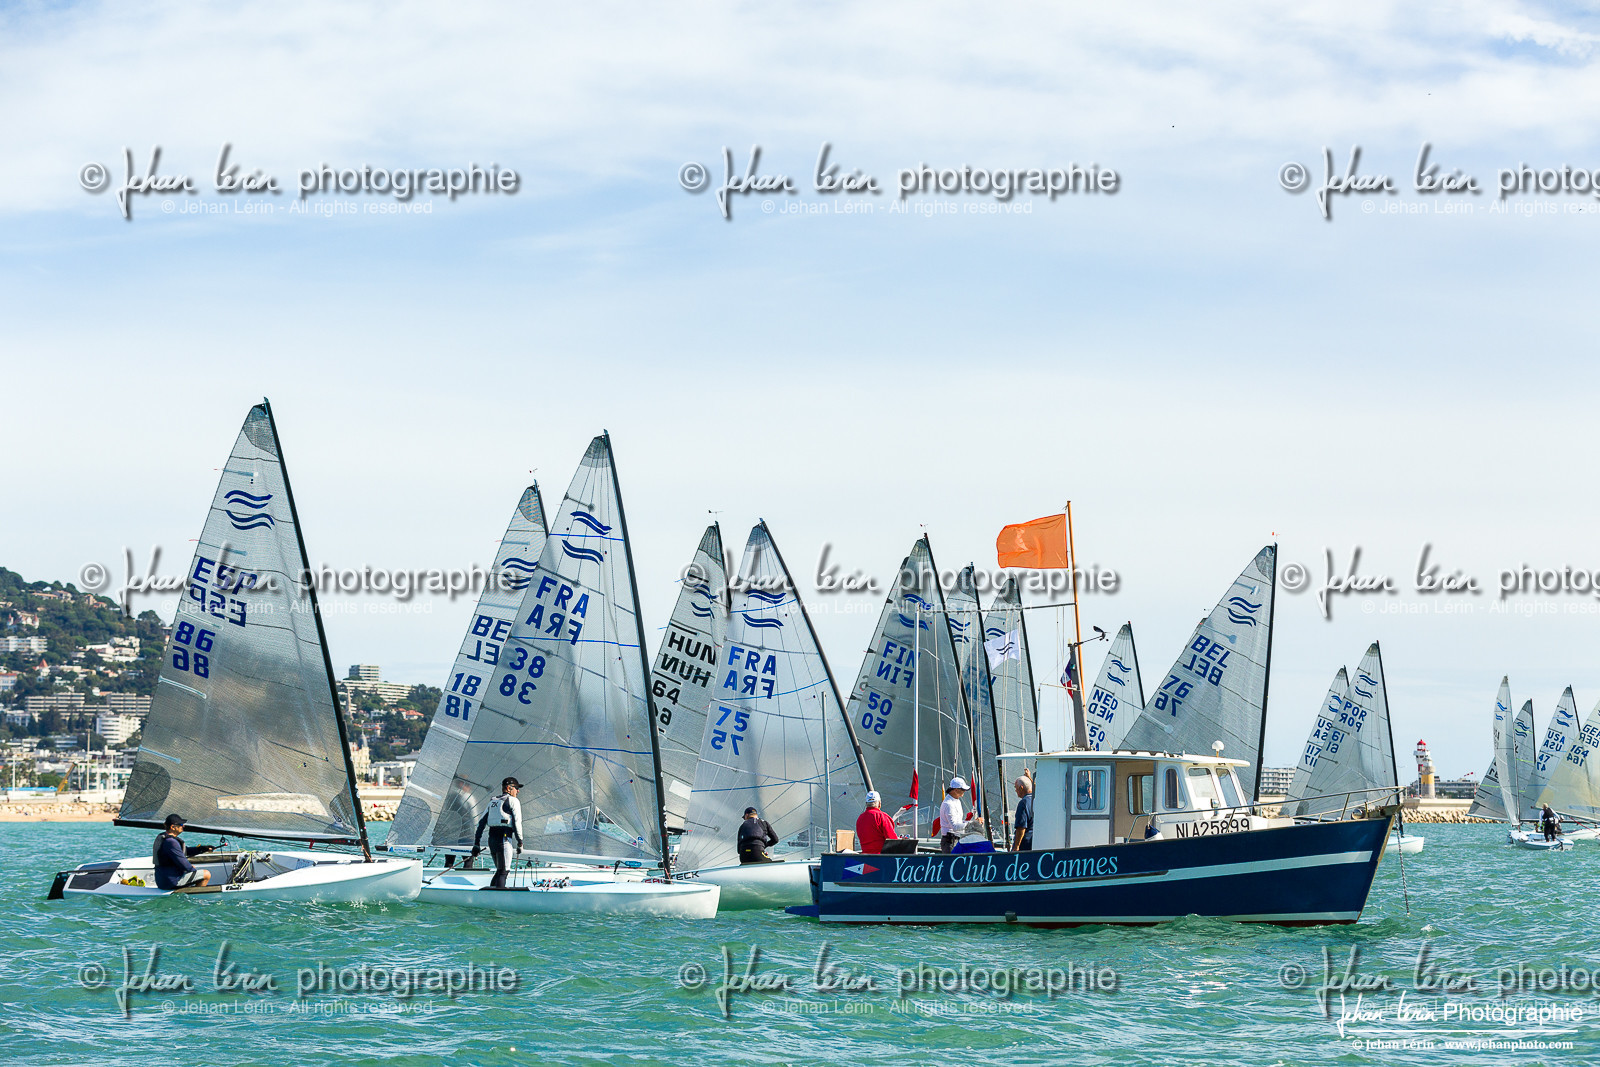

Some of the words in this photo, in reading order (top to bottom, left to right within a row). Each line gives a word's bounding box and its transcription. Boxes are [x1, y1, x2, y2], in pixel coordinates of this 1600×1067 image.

[193, 557, 257, 595] ESP
[536, 576, 590, 618] FRA
[175, 620, 216, 653] 86
[667, 631, 717, 666] HUN
[509, 647, 546, 679] 38
[728, 646, 776, 676] FRA
[882, 640, 921, 669] FIN
[1190, 634, 1231, 669] BEL
[451, 672, 482, 697] 18
[652, 680, 680, 705] 64
[1162, 674, 1194, 699] 76
[868, 691, 893, 716] 50
[1093, 689, 1118, 711] NED
[1342, 701, 1367, 721] POR
[715, 706, 750, 732] 75
[1331, 730, 1345, 743] 61
[1547, 730, 1566, 745] USA
[1306, 744, 1322, 757] 117
[1538, 753, 1551, 763] 47
[1570, 744, 1590, 758] 164
[892, 856, 944, 883] Yacht
[950, 854, 997, 883] Club
[1005, 853, 1030, 881] de
[1037, 852, 1118, 880] Cannes
